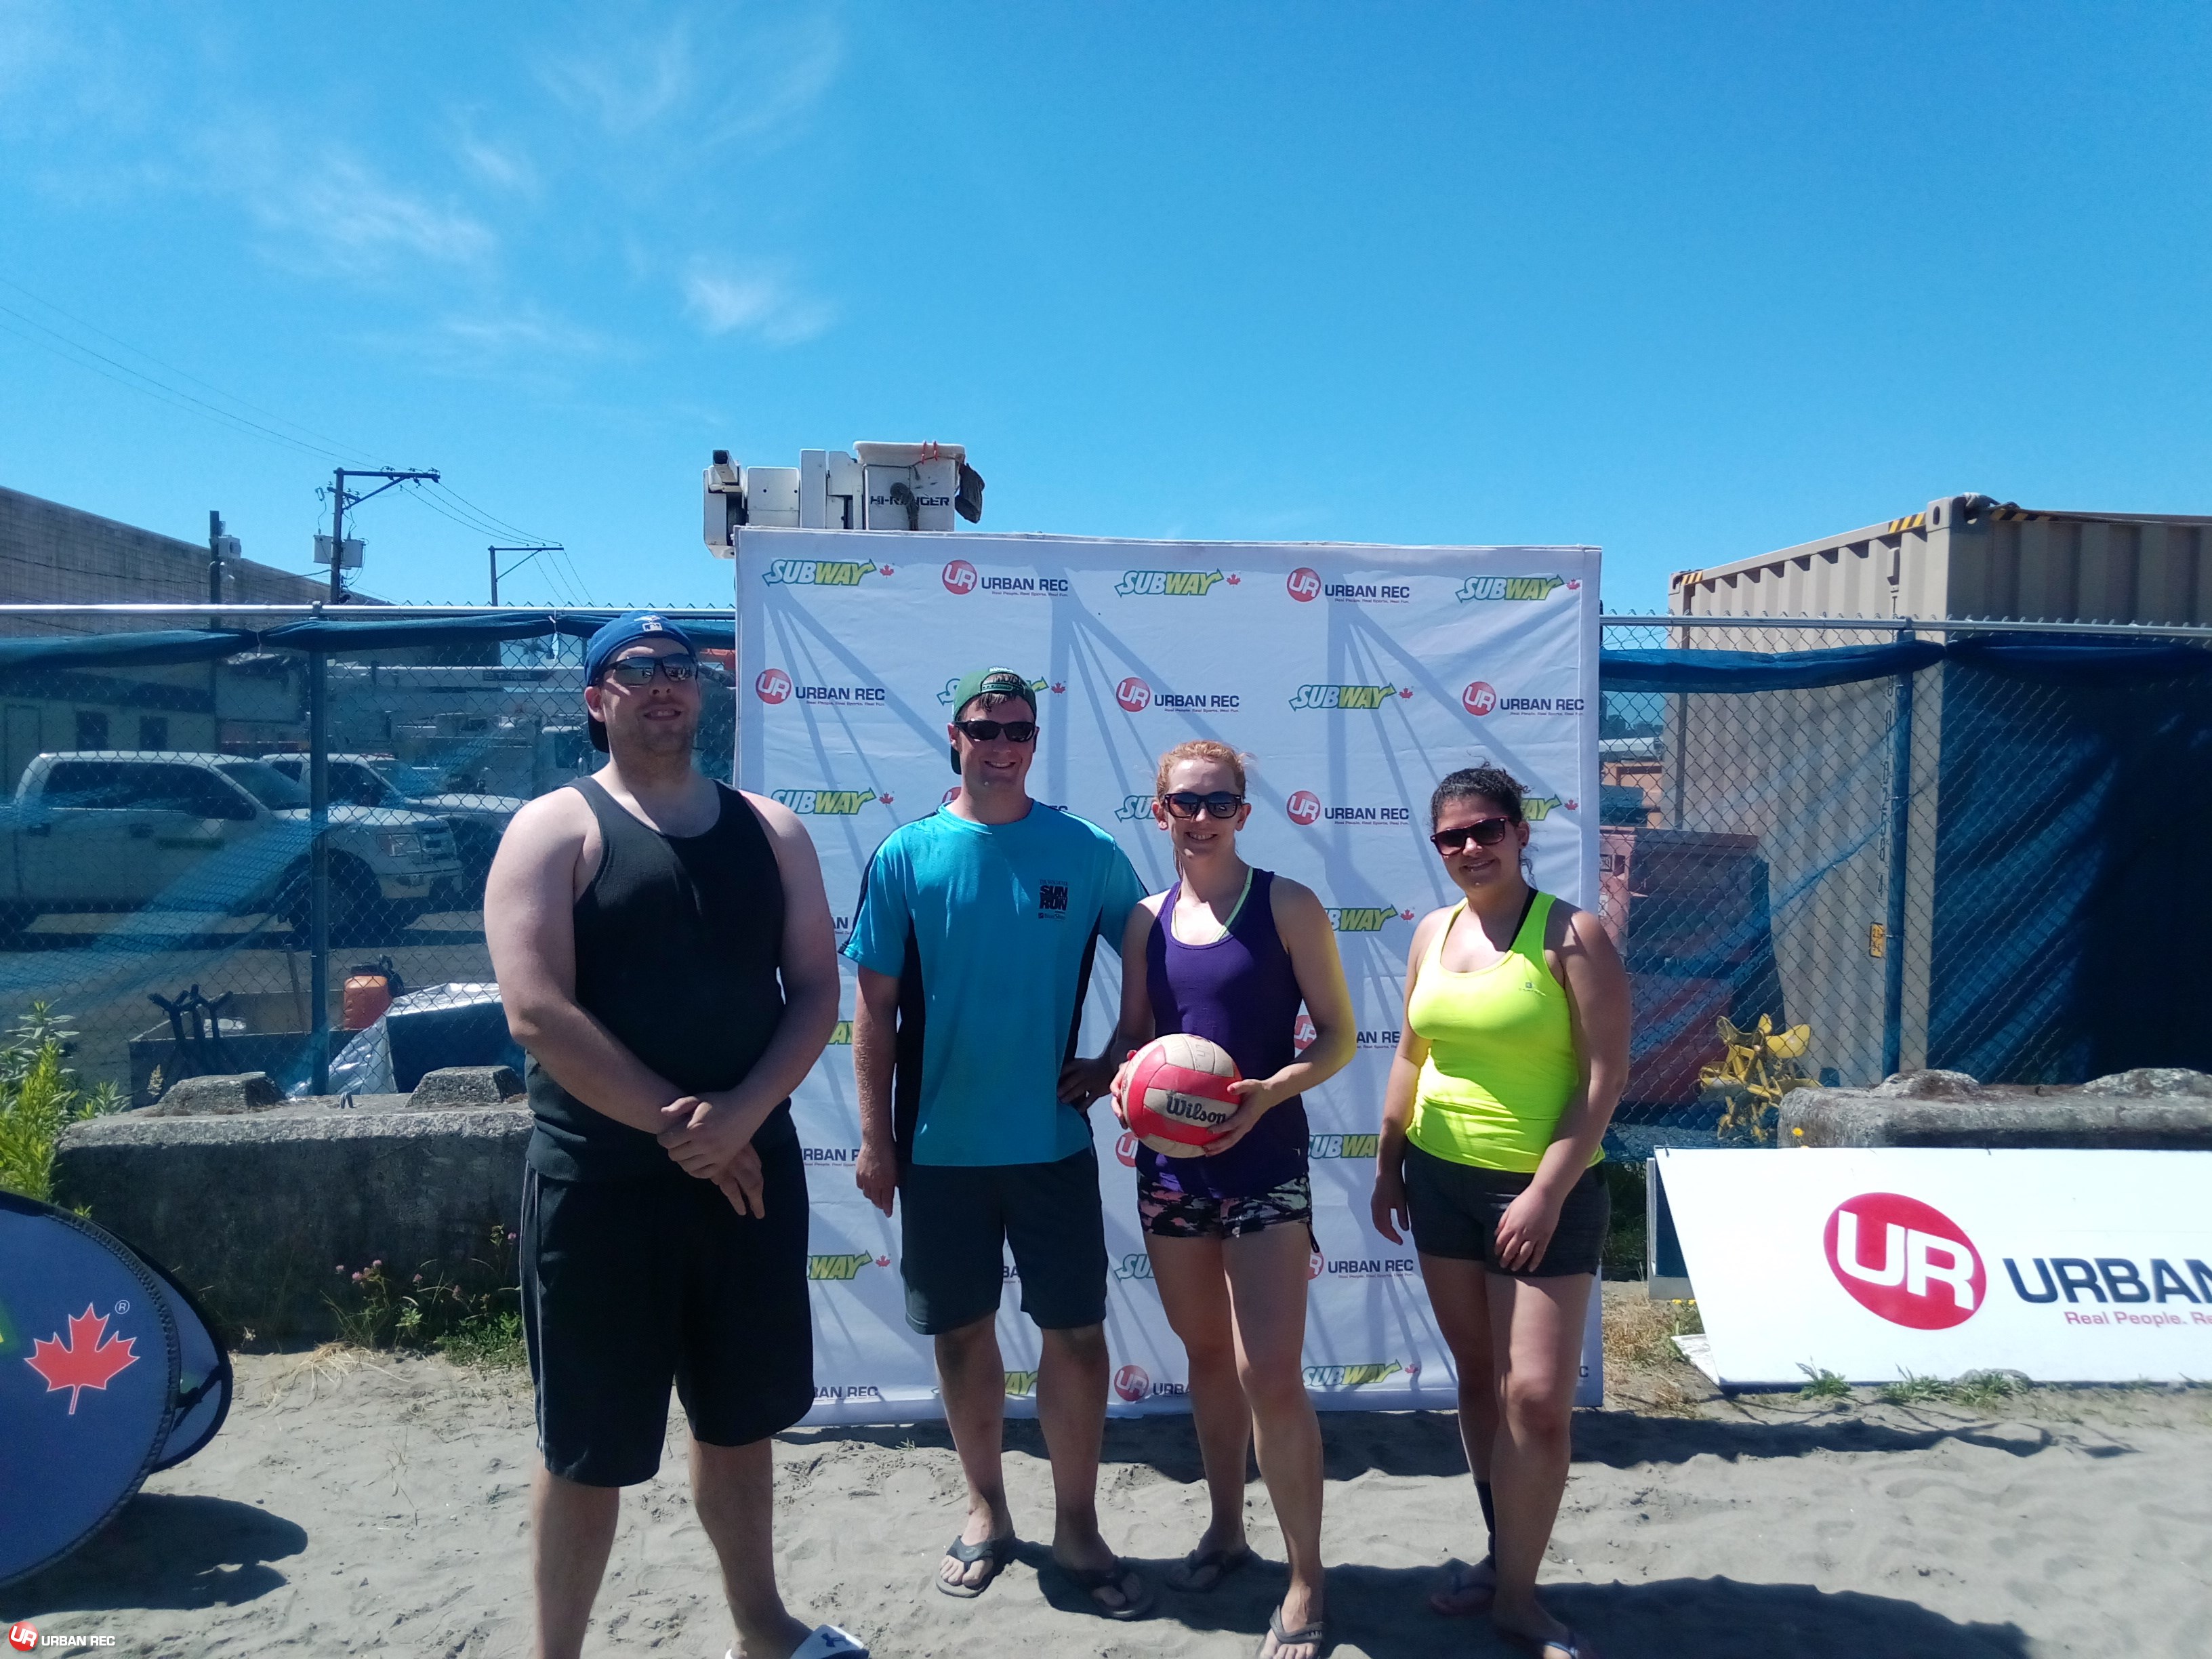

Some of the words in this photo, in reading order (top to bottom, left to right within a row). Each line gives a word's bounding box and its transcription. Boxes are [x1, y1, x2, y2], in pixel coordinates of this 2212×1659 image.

[870, 496, 949, 506] HI-RGER
[762, 558, 877, 587] SUBWAY
[944, 565, 977, 590] UR
[981, 577, 1034, 591] URBAN
[1039, 579, 1069, 592] REC
[1114, 568, 1224, 598] SUBWAY
[1288, 572, 1319, 598] UR
[1325, 584, 1376, 598] URBAN
[1381, 586, 1410, 598] REC
[1455, 574, 1564, 603] SUBWAY
[758, 673, 790, 700] UR
[795, 687, 850, 700] URBAN
[855, 688, 886, 701] REC
[1118, 682, 1149, 708] UR
[1154, 695, 1206, 707] URBAN
[1211, 695, 1240, 708] REC
[1288, 682, 1397, 712] SUBWAY
[1465, 686, 1494, 712] UR
[1500, 699, 1551, 710] URBAN
[1555, 699, 1584, 710] REC
[1288, 796, 1319, 821] UR
[1324, 807, 1376, 819] URBAN
[1380, 808, 1410, 820] REC
[1039, 885, 1069, 897] SUN
[1039, 896, 1068, 910] RUN
[1324, 904, 1399, 932] BWAY
[1381, 1031, 1401, 1044] RE
[1166, 1094, 1227, 1124] Wilson
[801, 1148, 846, 1161] RBAN
[1309, 1134, 1380, 1160] UBWA
[808, 1250, 873, 1280] WAY
[1328, 1260, 1380, 1273] URBAN
[1385, 1259, 1414, 1272] REC
[1837, 1210, 1975, 1311] UR
[2064, 1311, 2110, 1326] Real
[2113, 1311, 2187, 1328] People.
[1116, 1370, 1148, 1396] UR
[1153, 1382, 1189, 1396] URB
[1302, 1359, 1403, 1387] SUBWAY
[847, 1386, 878, 1397] REC
